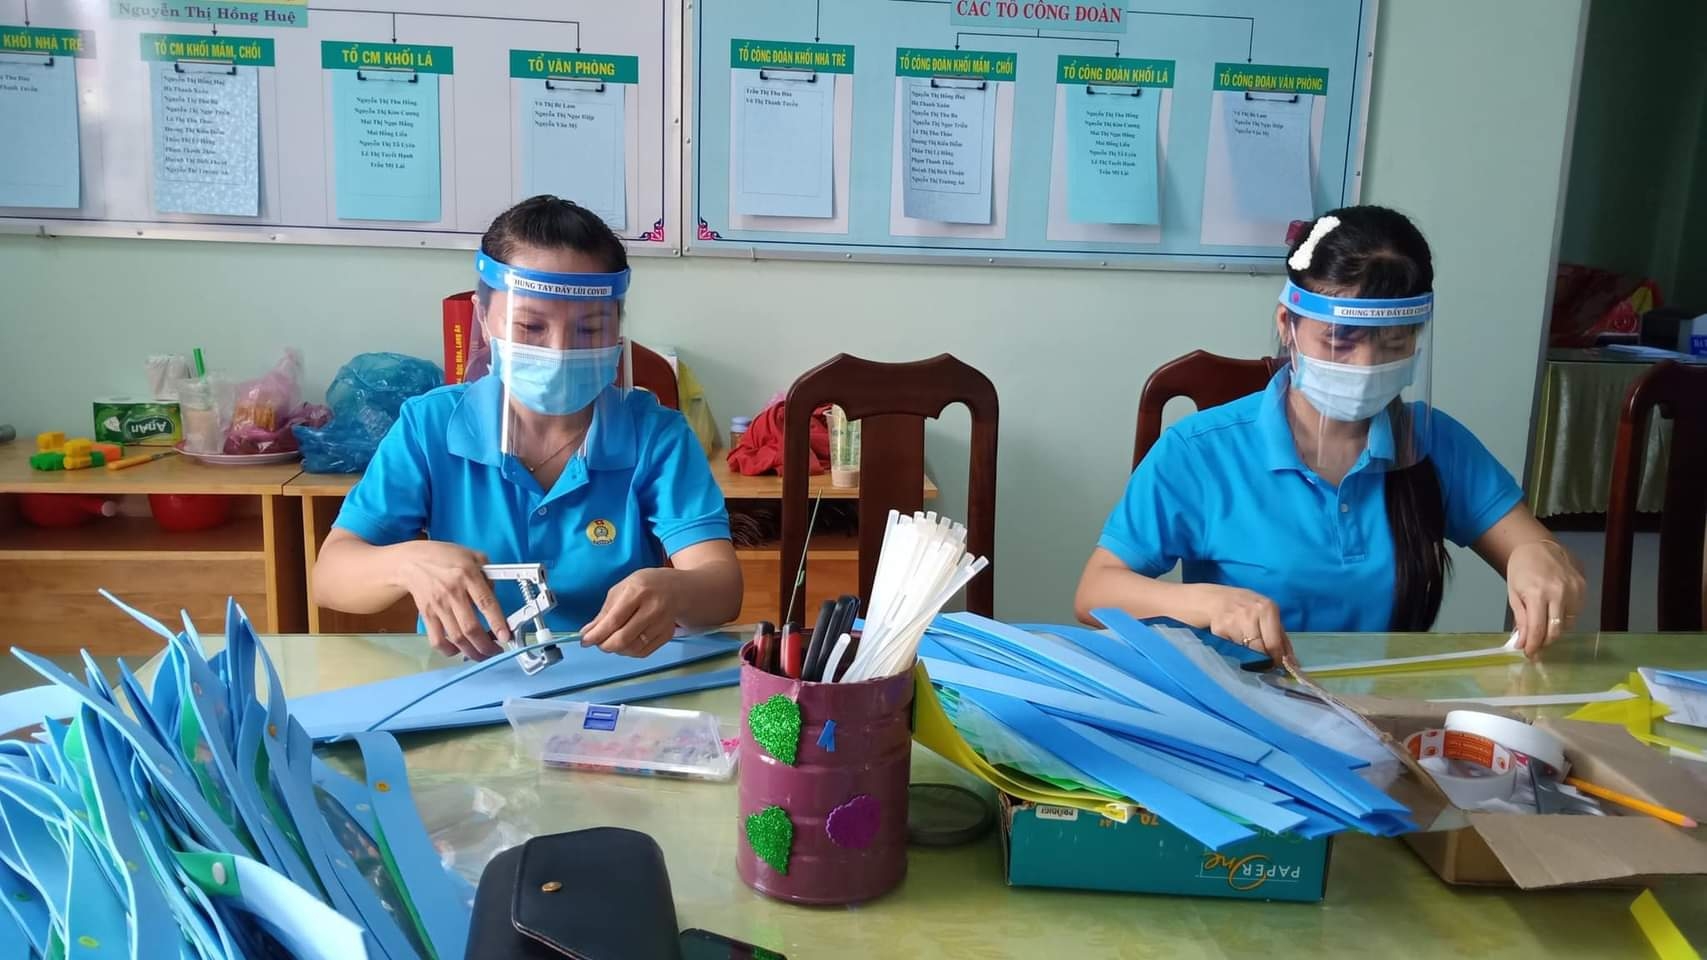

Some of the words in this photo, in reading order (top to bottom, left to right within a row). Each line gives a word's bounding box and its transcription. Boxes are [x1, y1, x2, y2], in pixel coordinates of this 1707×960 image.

[184, 6, 210, 21] Thị
[264, 10, 296, 24] Huệ
[1023, 0, 1069, 21] CÔNG
[1075, 3, 1122, 23] ĐOÀN
[170, 42, 184, 56] CM
[342, 44, 359, 62] TỔ
[362, 51, 380, 64] CM
[384, 48, 414, 65] KHỐI
[418, 50, 432, 66] LÁ
[751, 46, 771, 62] CÔNG
[773, 47, 792, 64] ĐOÀN
[528, 53, 544, 72] TỔ
[548, 58, 571, 73] VĂN
[575, 59, 615, 76] PHÒNG
[1078, 64, 1102, 80] CÔNG
[1106, 65, 1130, 81] ĐOÀN
[1157, 67, 1168, 83] LÁ
[1232, 72, 1254, 88] CÔNG
[1242, 864, 1300, 878] PAPER
